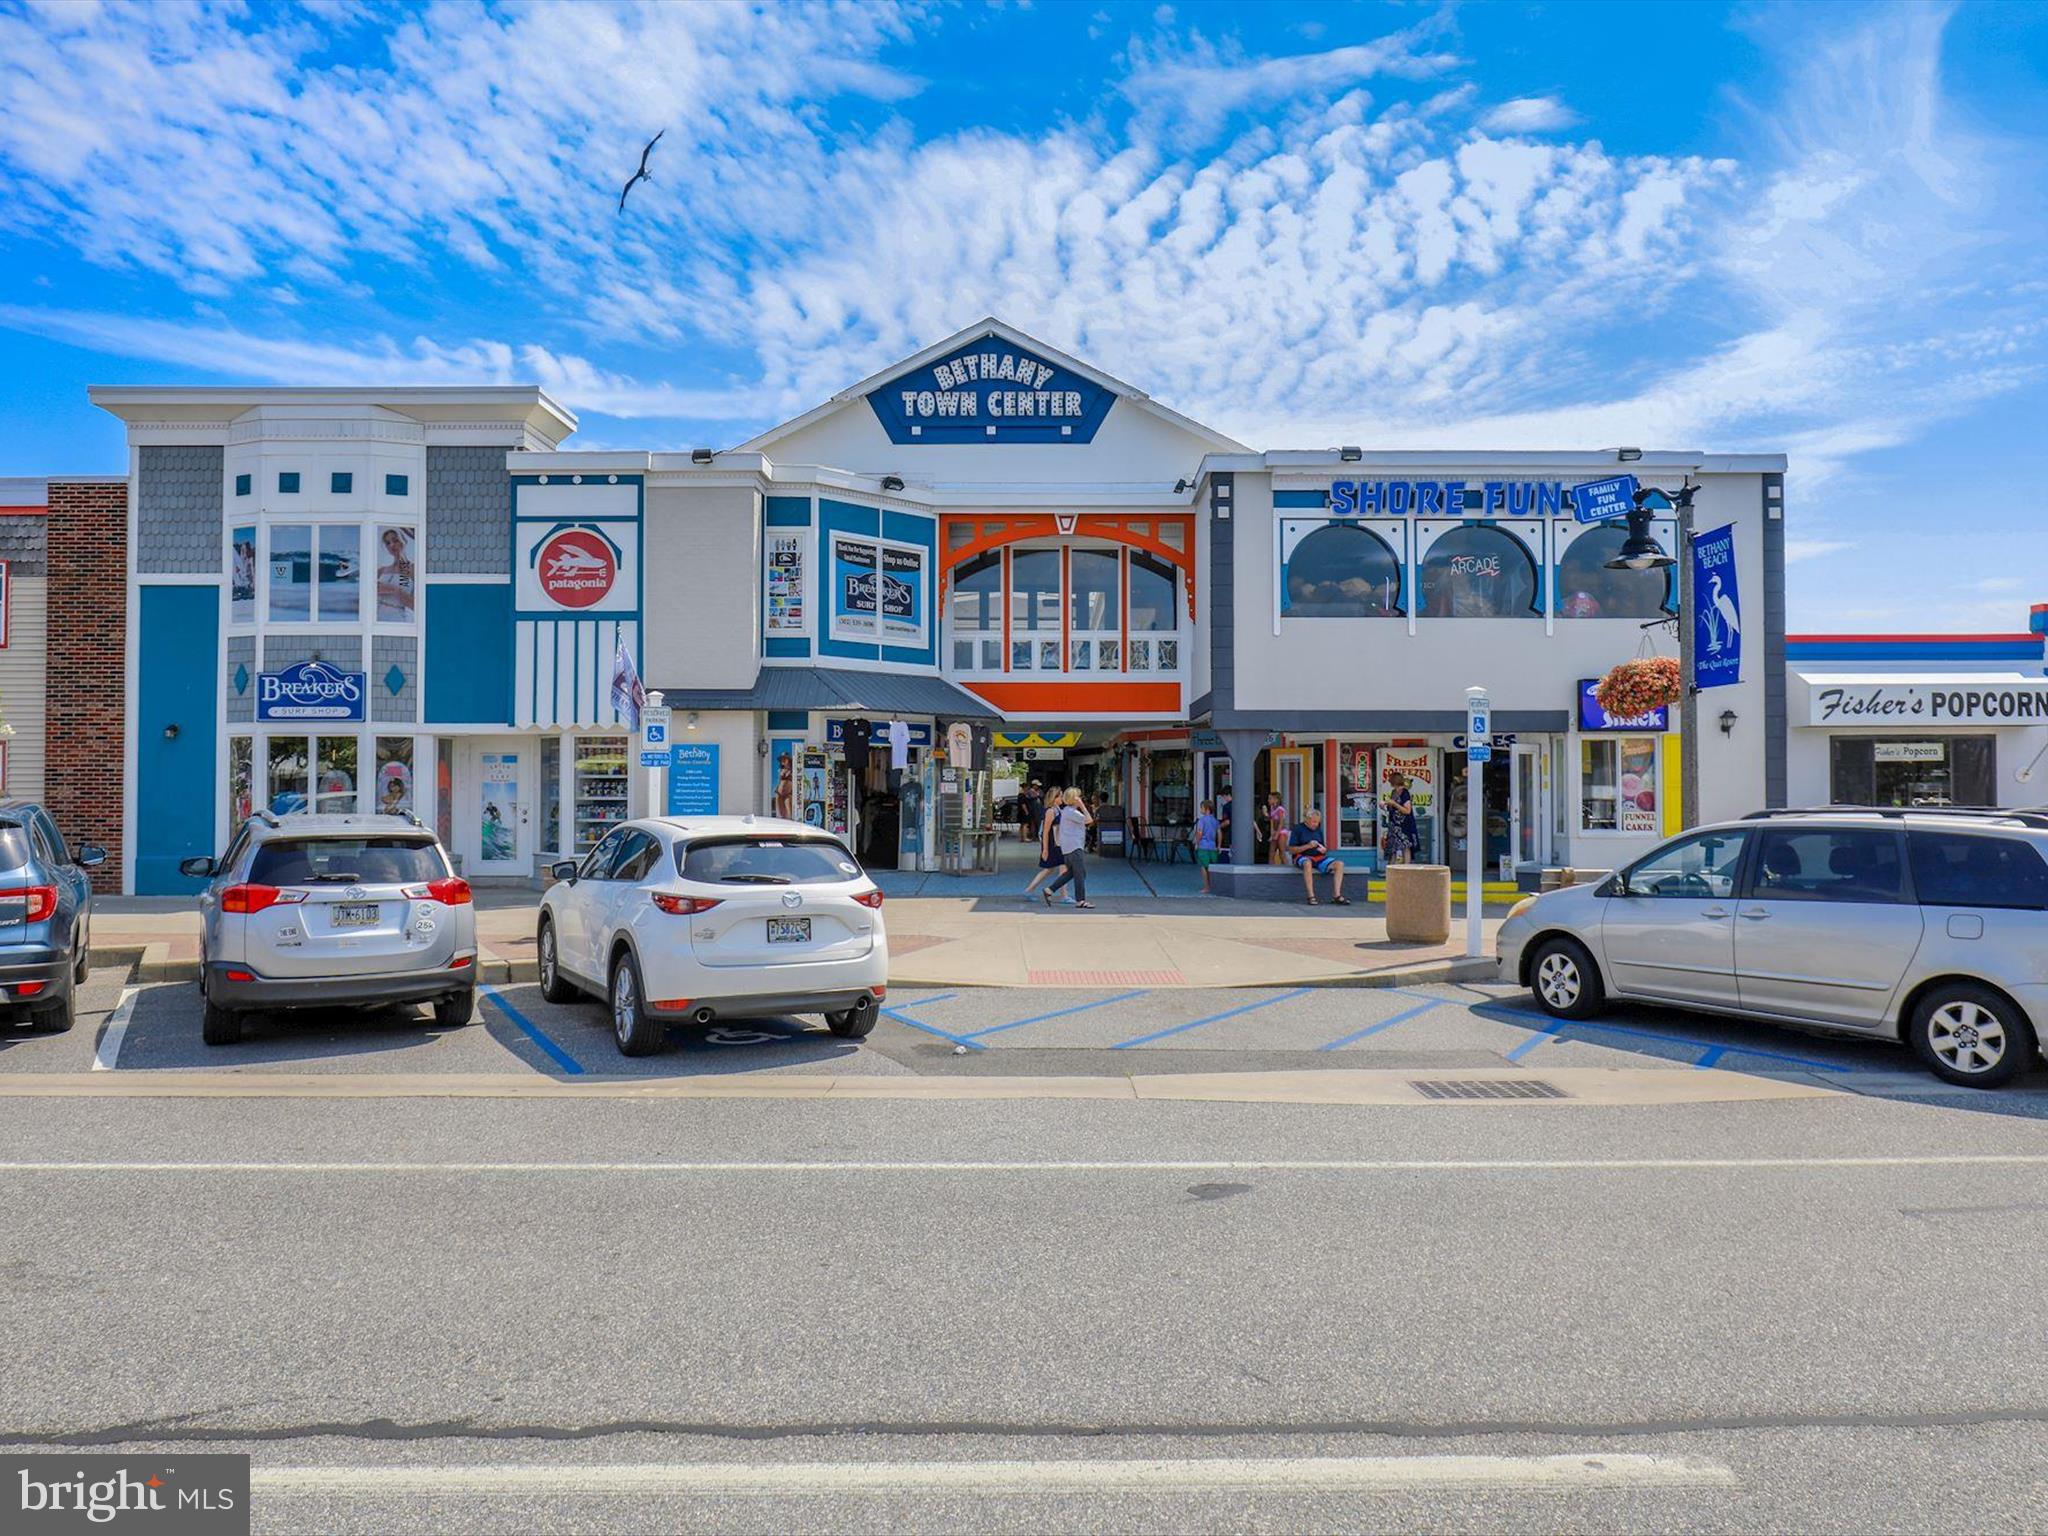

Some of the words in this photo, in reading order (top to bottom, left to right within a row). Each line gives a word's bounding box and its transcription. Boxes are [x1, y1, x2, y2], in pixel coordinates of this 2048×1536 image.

[933, 353, 1054, 391] BETHANY
[902, 391, 977, 417] TOWN
[987, 391, 1082, 417] CENTER
[1588, 482, 1620, 496] FAMILY
[1331, 481, 1467, 516] SHORE
[1484, 481, 1562, 516] FUN
[1598, 493, 1616, 504] FUN
[1590, 502, 1627, 518] CENTER
[1698, 538, 1730, 559] BETHANY
[883, 554, 896, 566] Shop
[1450, 555, 1500, 576] ARCADE
[1703, 552, 1728, 569] BEACH
[549, 578, 606, 590] patagonia
[856, 600, 876, 609] SURF
[884, 604, 904, 614] SHOP
[1697, 660, 1708, 670] The
[261, 675, 360, 702] BREAKERS
[281, 707, 306, 715] SURF
[312, 707, 338, 715] SHOP
[1819, 689, 1924, 720] Fisher's
[1931, 692, 2048, 717] POPCORN
[1453, 734, 1517, 749] CES
[678, 747, 711, 764] Bethany
[1903, 745, 1938, 759] Popcorn
[1386, 753, 1428, 767] FRESH
[1625, 813, 1655, 822] FUNNEL
[1626, 823, 1653, 832] CAKES
